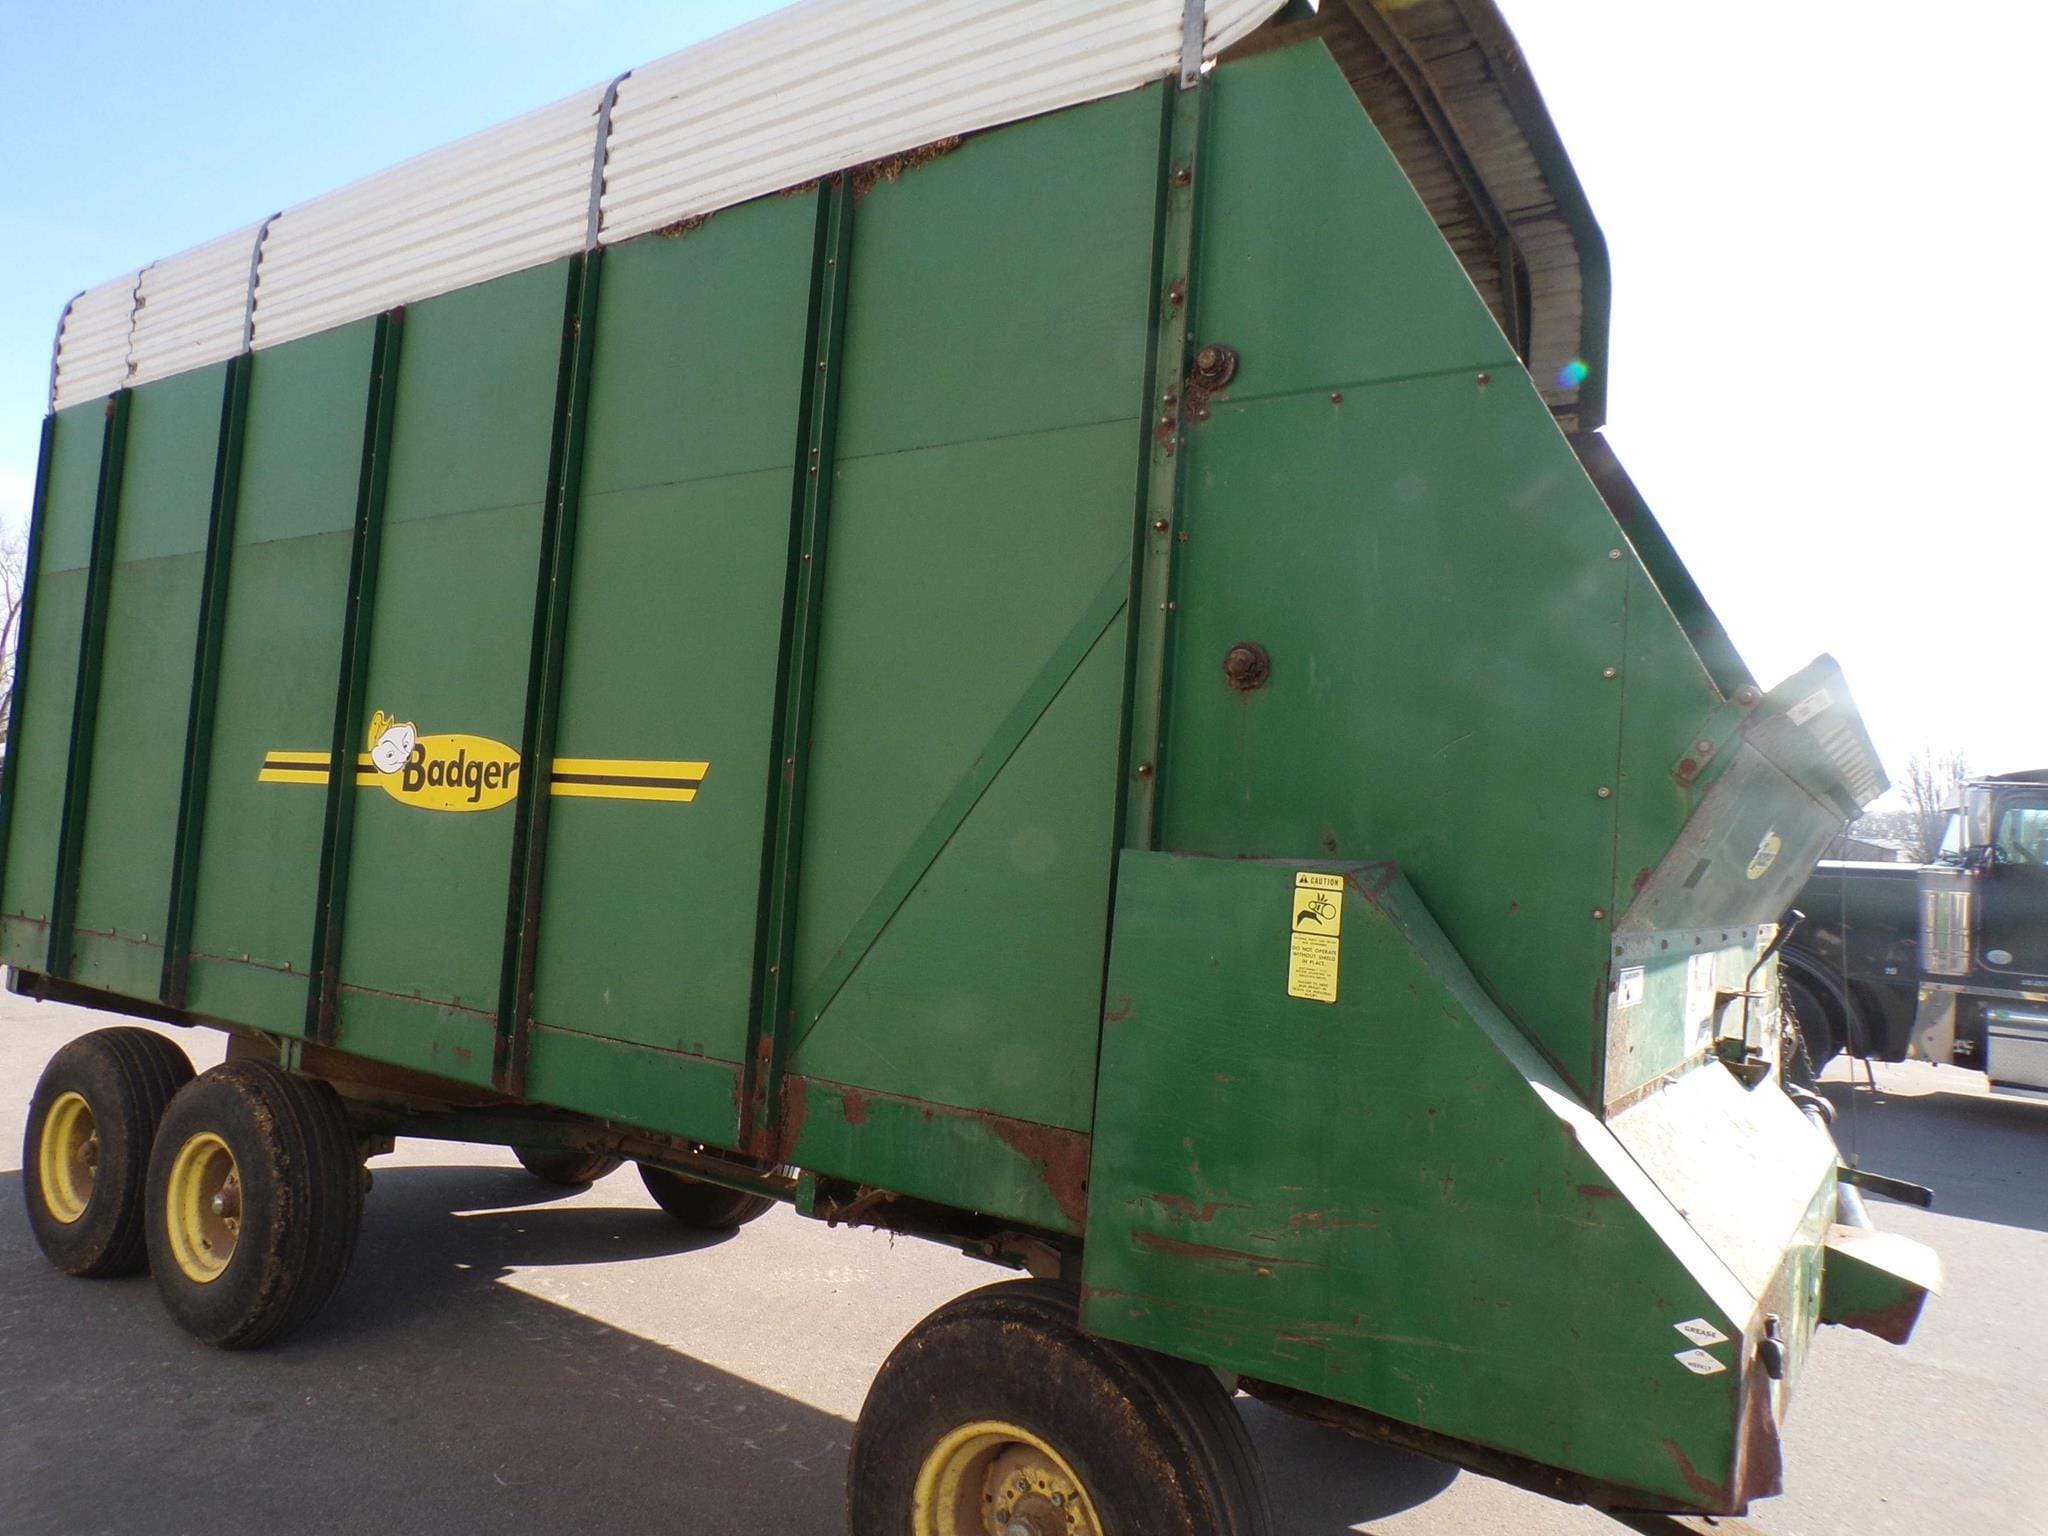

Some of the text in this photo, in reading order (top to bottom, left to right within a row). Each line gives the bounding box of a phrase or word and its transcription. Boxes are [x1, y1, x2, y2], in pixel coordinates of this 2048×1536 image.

[402, 743, 520, 803] Badger
[1310, 877, 1339, 887] CAUTION
[1293, 951, 1316, 959] WITHOUT
[1314, 948, 1337, 956] OPERATE
[1684, 1325, 1716, 1338] GREASE
[1687, 1361, 1712, 1371] WEEKLY
